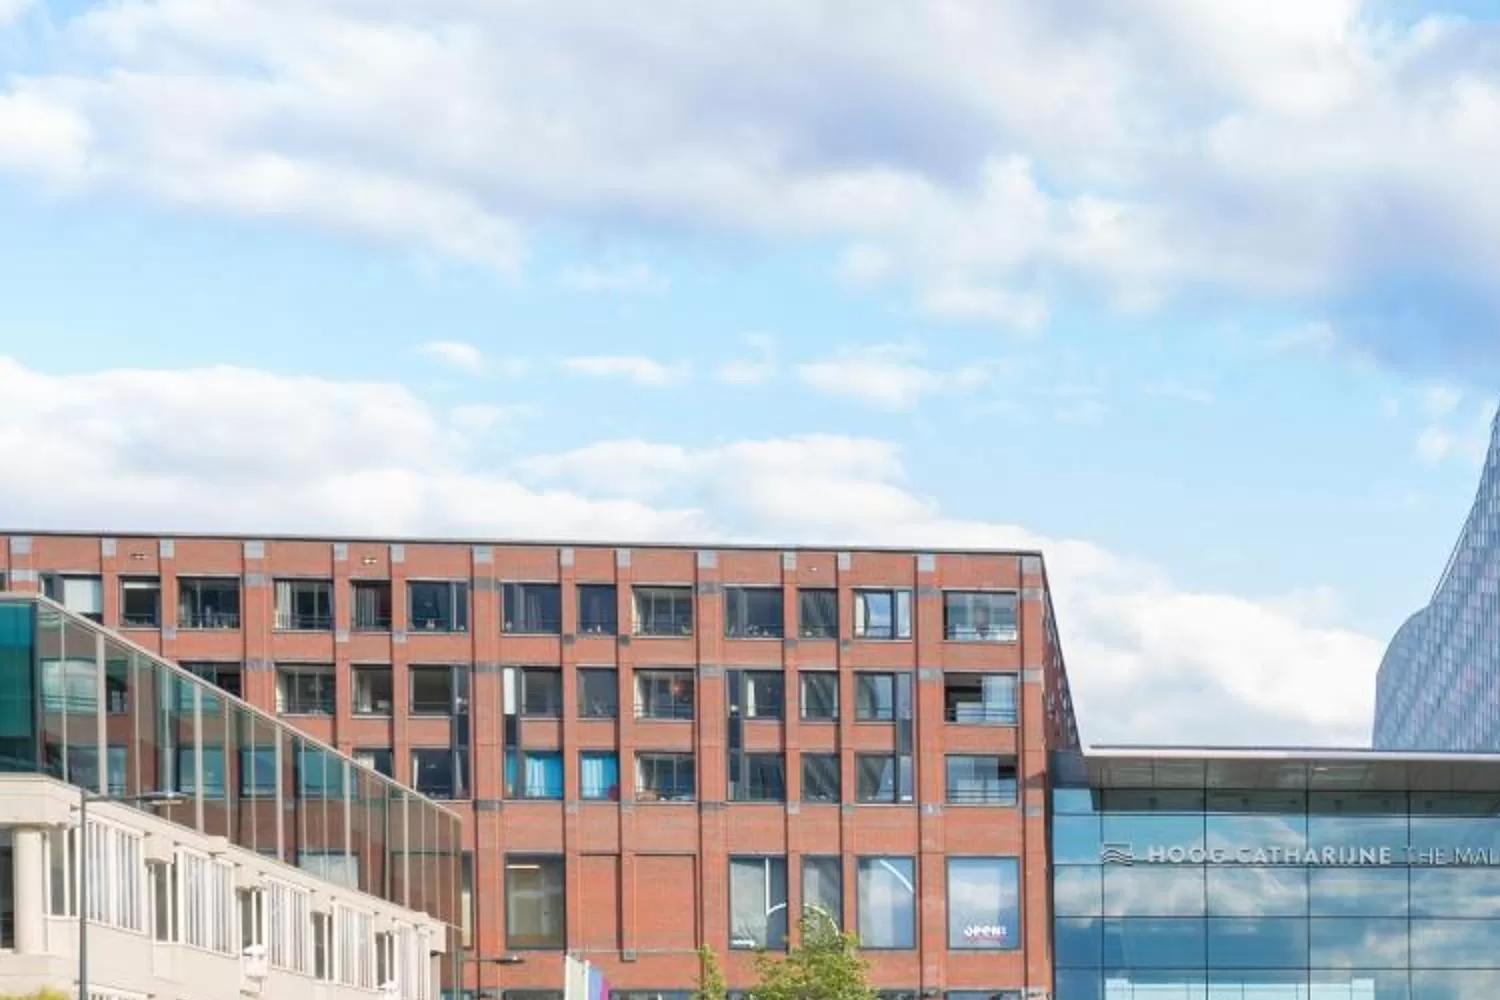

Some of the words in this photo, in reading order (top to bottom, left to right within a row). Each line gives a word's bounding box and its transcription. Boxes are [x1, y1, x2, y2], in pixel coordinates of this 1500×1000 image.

[1148, 845, 1225, 864] HOOG
[1235, 845, 1392, 866] CATHARIJNE
[1403, 847, 1446, 866] THE
